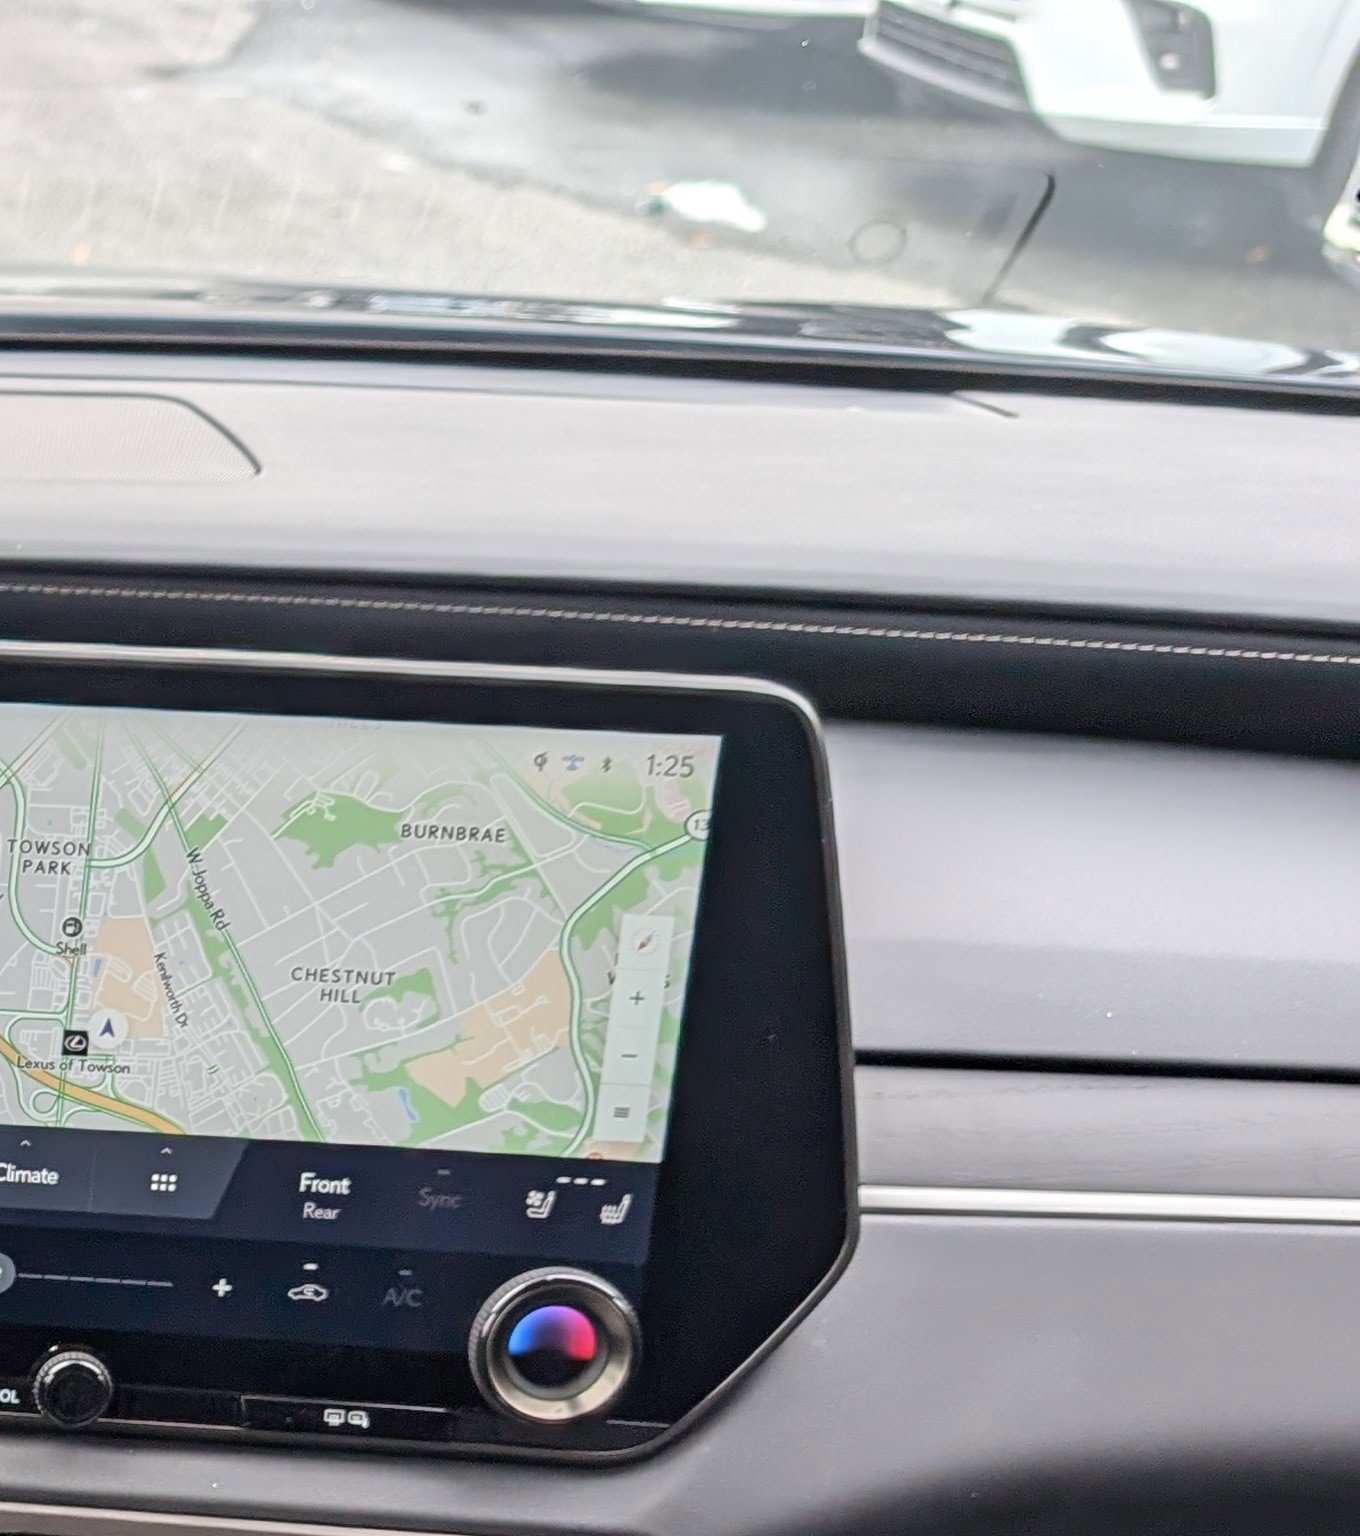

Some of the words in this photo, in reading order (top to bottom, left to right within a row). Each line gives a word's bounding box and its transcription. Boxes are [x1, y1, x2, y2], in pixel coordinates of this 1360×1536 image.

[646, 754, 696, 778] 1:25
[400, 823, 507, 844] BURNBRAE
[8, 838, 91, 857] TOWSON
[186, 847, 203, 865] W
[22, 858, 72, 876] PARK
[191, 869, 215, 911] Joppa
[208, 908, 231, 932] Rd
[56, 942, 87, 956] Shell
[290, 966, 396, 987] CHESTNUT
[319, 987, 362, 1005] HILL
[16, 1056, 55, 1072] Lexus
[59, 1057, 74, 1071] of
[79, 1058, 130, 1074] Towson
[300, 1171, 352, 1196] Front
[302, 1201, 341, 1221] Rear
[383, 1286, 423, 1309] A/C
